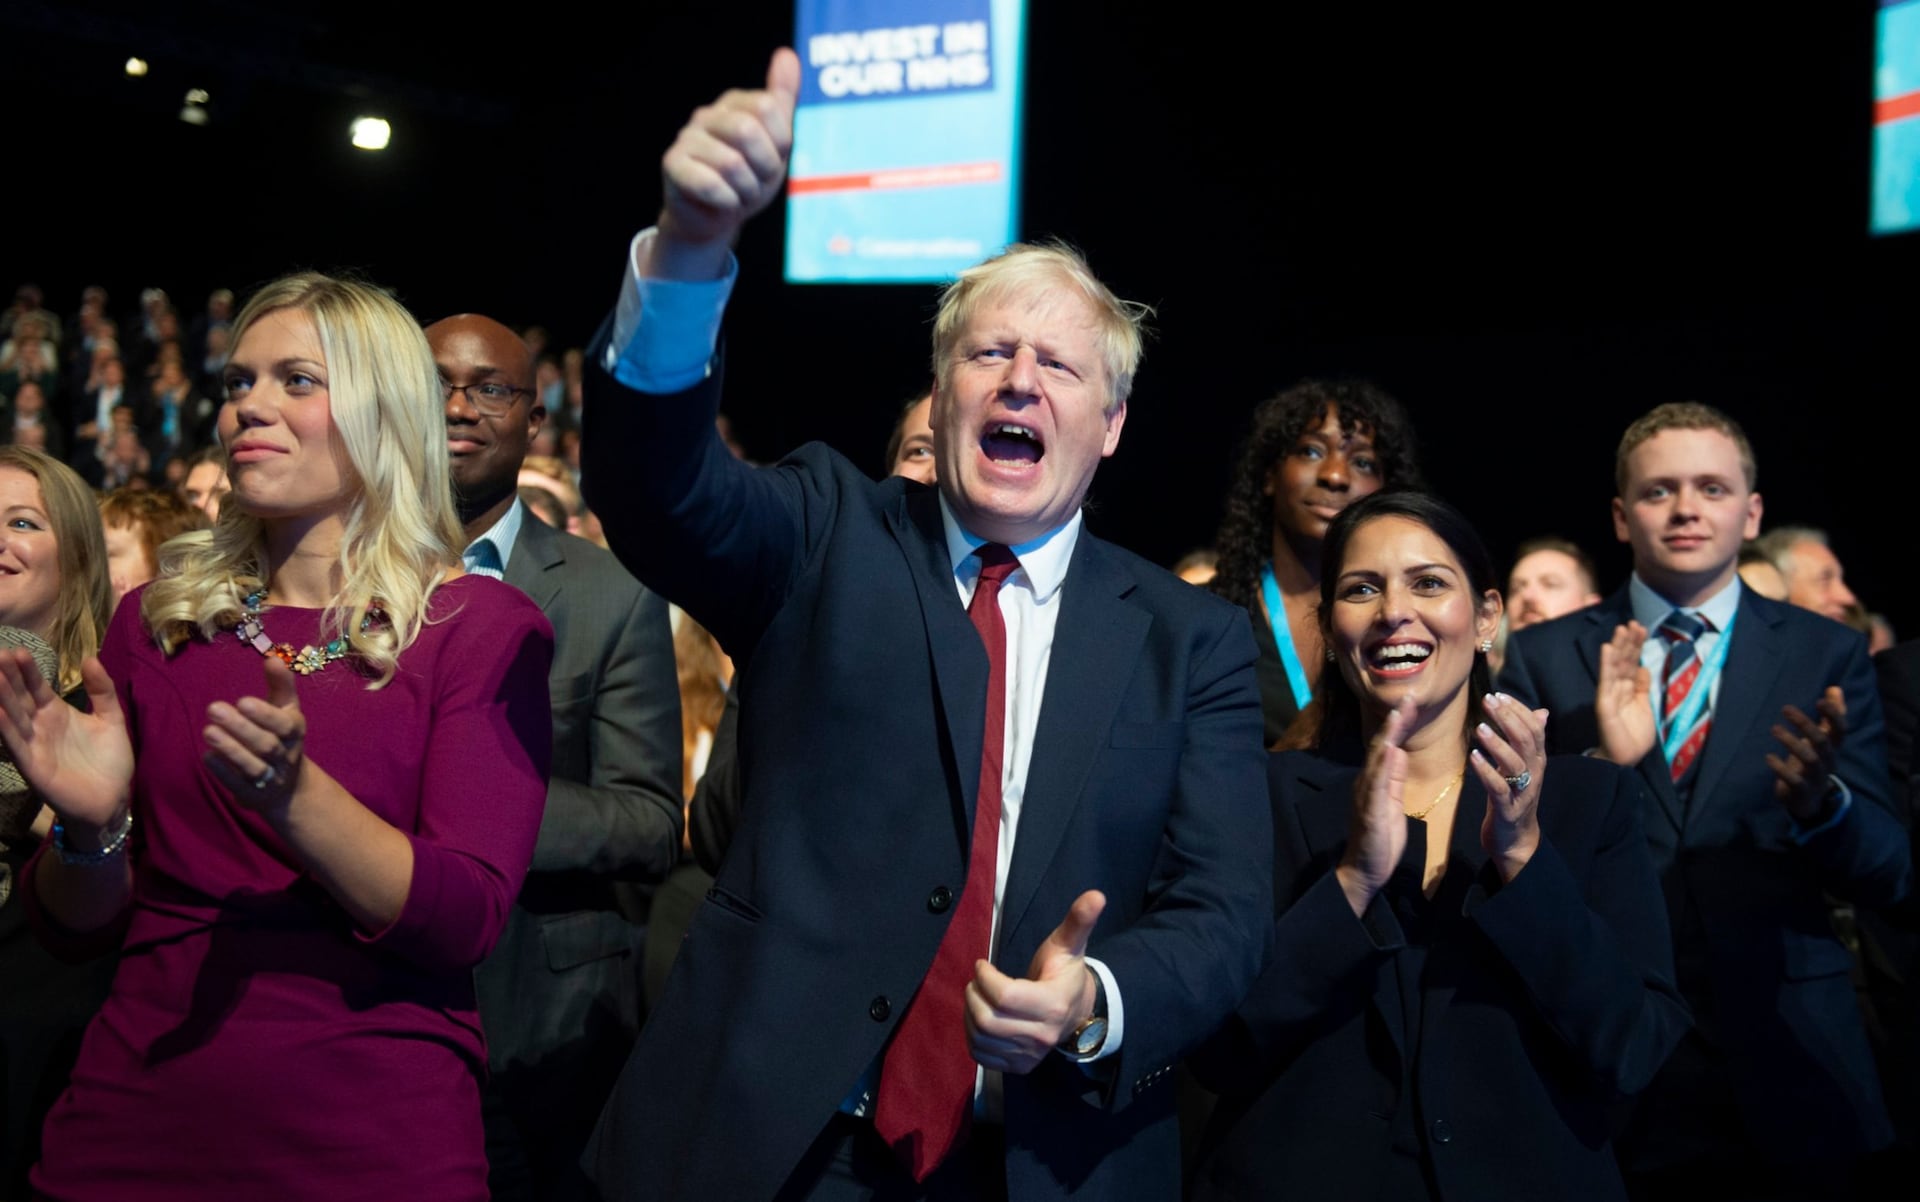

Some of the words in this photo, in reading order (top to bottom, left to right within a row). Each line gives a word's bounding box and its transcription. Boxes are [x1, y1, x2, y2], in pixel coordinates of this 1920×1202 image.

[809, 26, 939, 68] INVEST
[942, 20, 987, 55] IN
[818, 60, 902, 97] OUR
[906, 53, 990, 91] NHS
